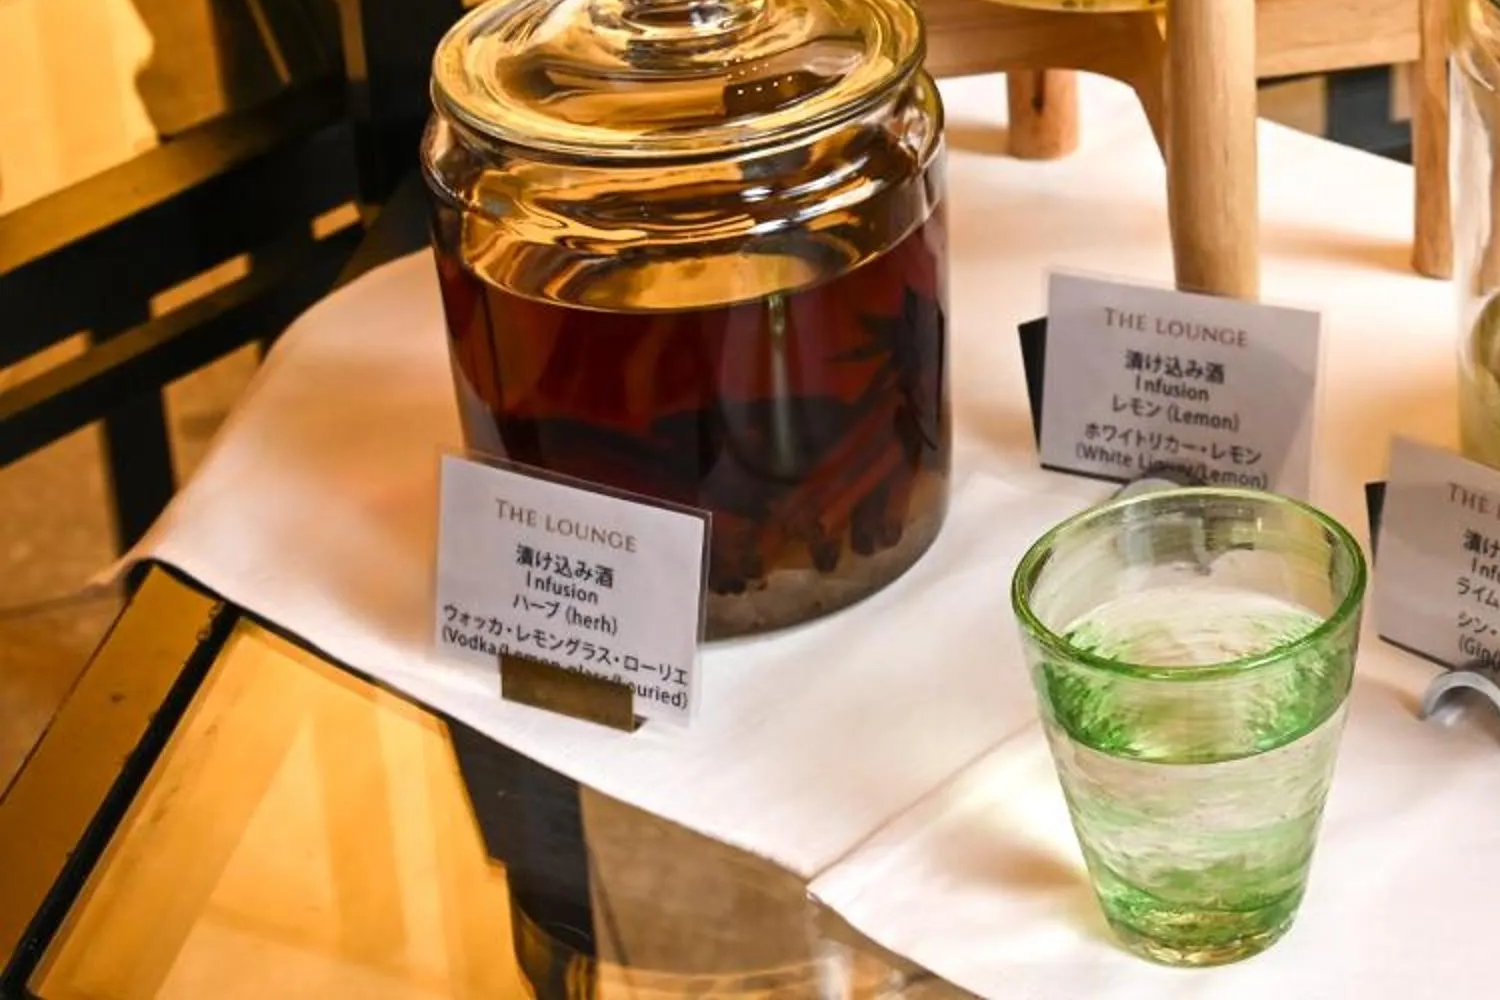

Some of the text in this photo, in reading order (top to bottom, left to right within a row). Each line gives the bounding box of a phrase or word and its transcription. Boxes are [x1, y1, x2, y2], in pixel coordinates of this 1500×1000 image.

[1103, 307, 1248, 348] THE LOUNGE
[1135, 375, 1210, 402] Infusion
[1112, 395, 1240, 433] レモン (Lemon)
[1075, 443, 1133, 468] (White
[1449, 482, 1490, 514] THE
[495, 498, 637, 553] THE LOUNGE
[526, 571, 599, 605] Infusion
[1457, 577, 1500, 608] ライム
